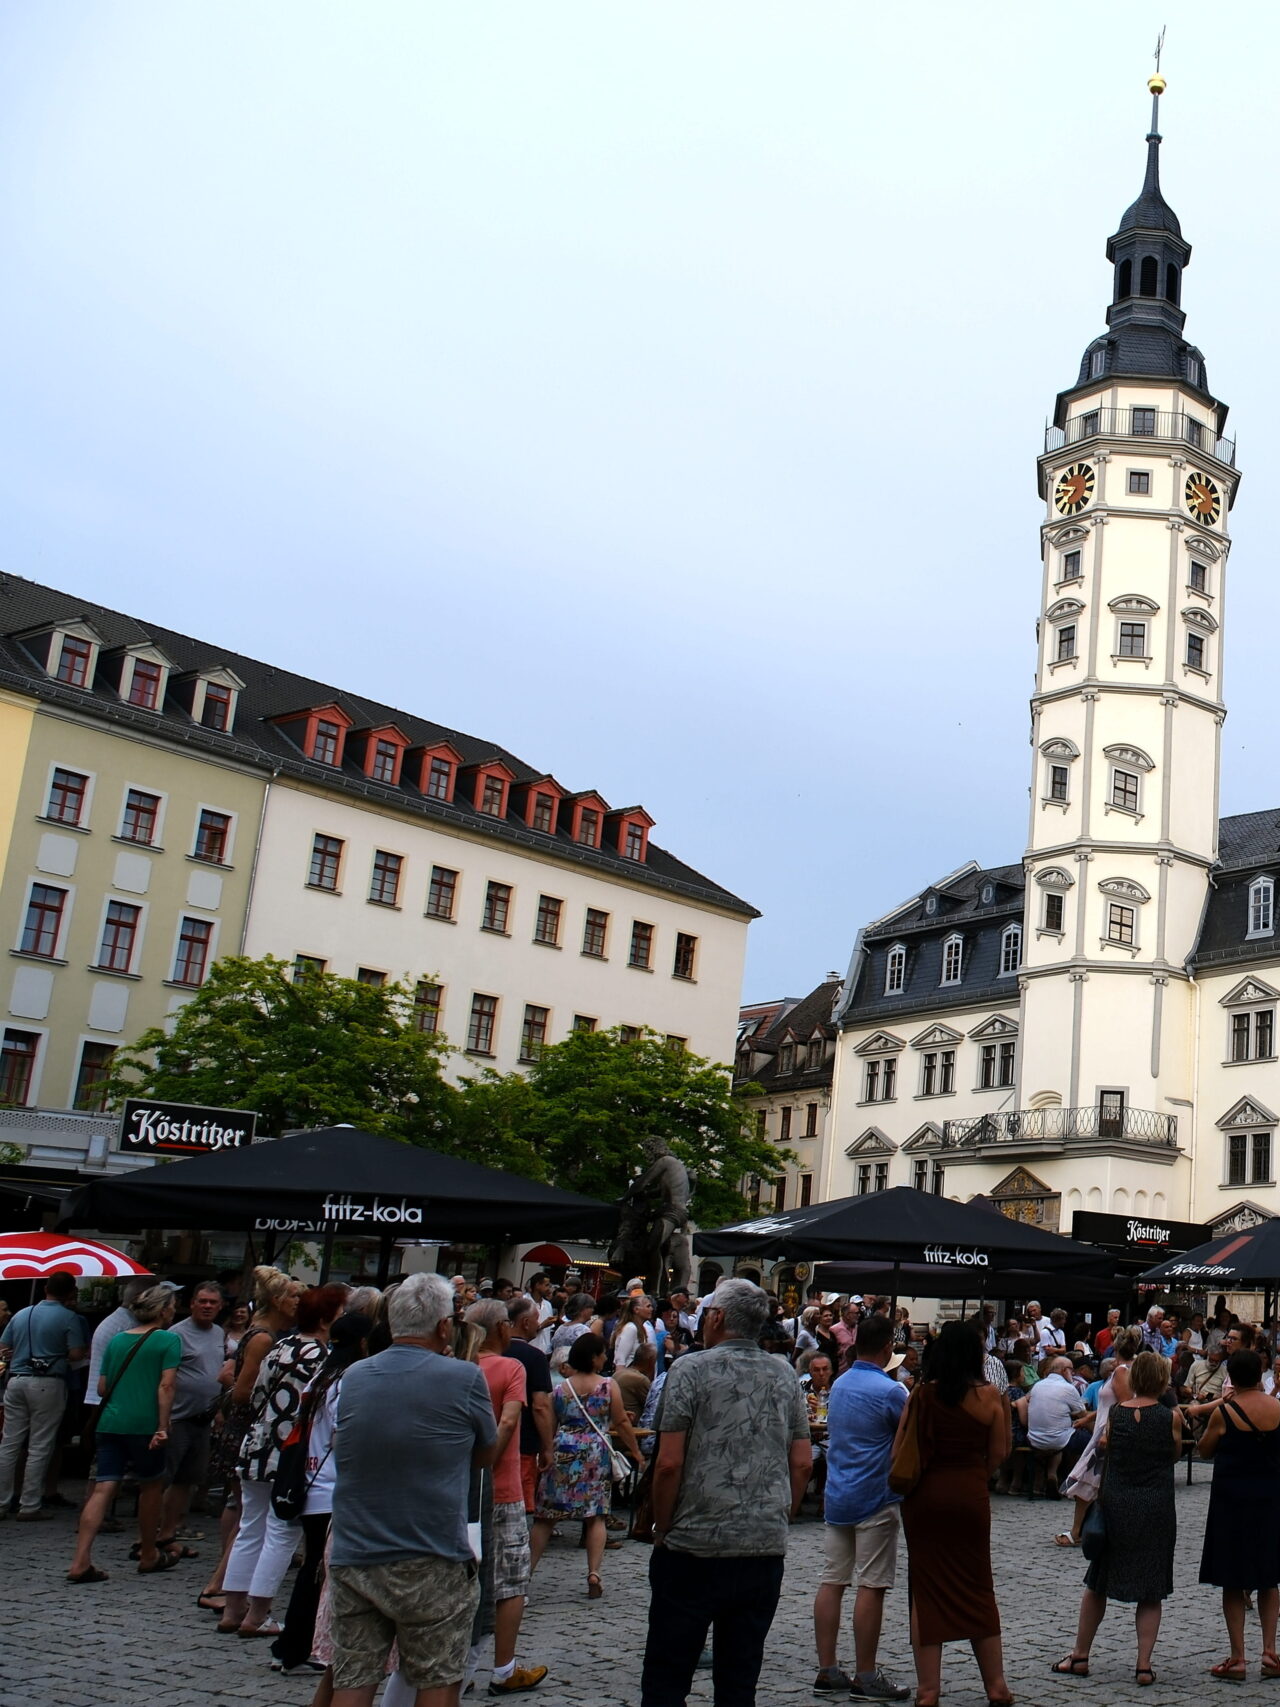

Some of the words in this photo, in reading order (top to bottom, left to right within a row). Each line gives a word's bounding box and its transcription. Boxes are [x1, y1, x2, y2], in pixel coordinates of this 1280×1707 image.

[128, 1109, 245, 1151] Köstritzer
[322, 1193, 423, 1223] fritz-kola
[1127, 1220, 1171, 1243] Köstritzer
[923, 1243, 989, 1266] fritz-kola
[1164, 1263, 1236, 1277] Köstritzer
